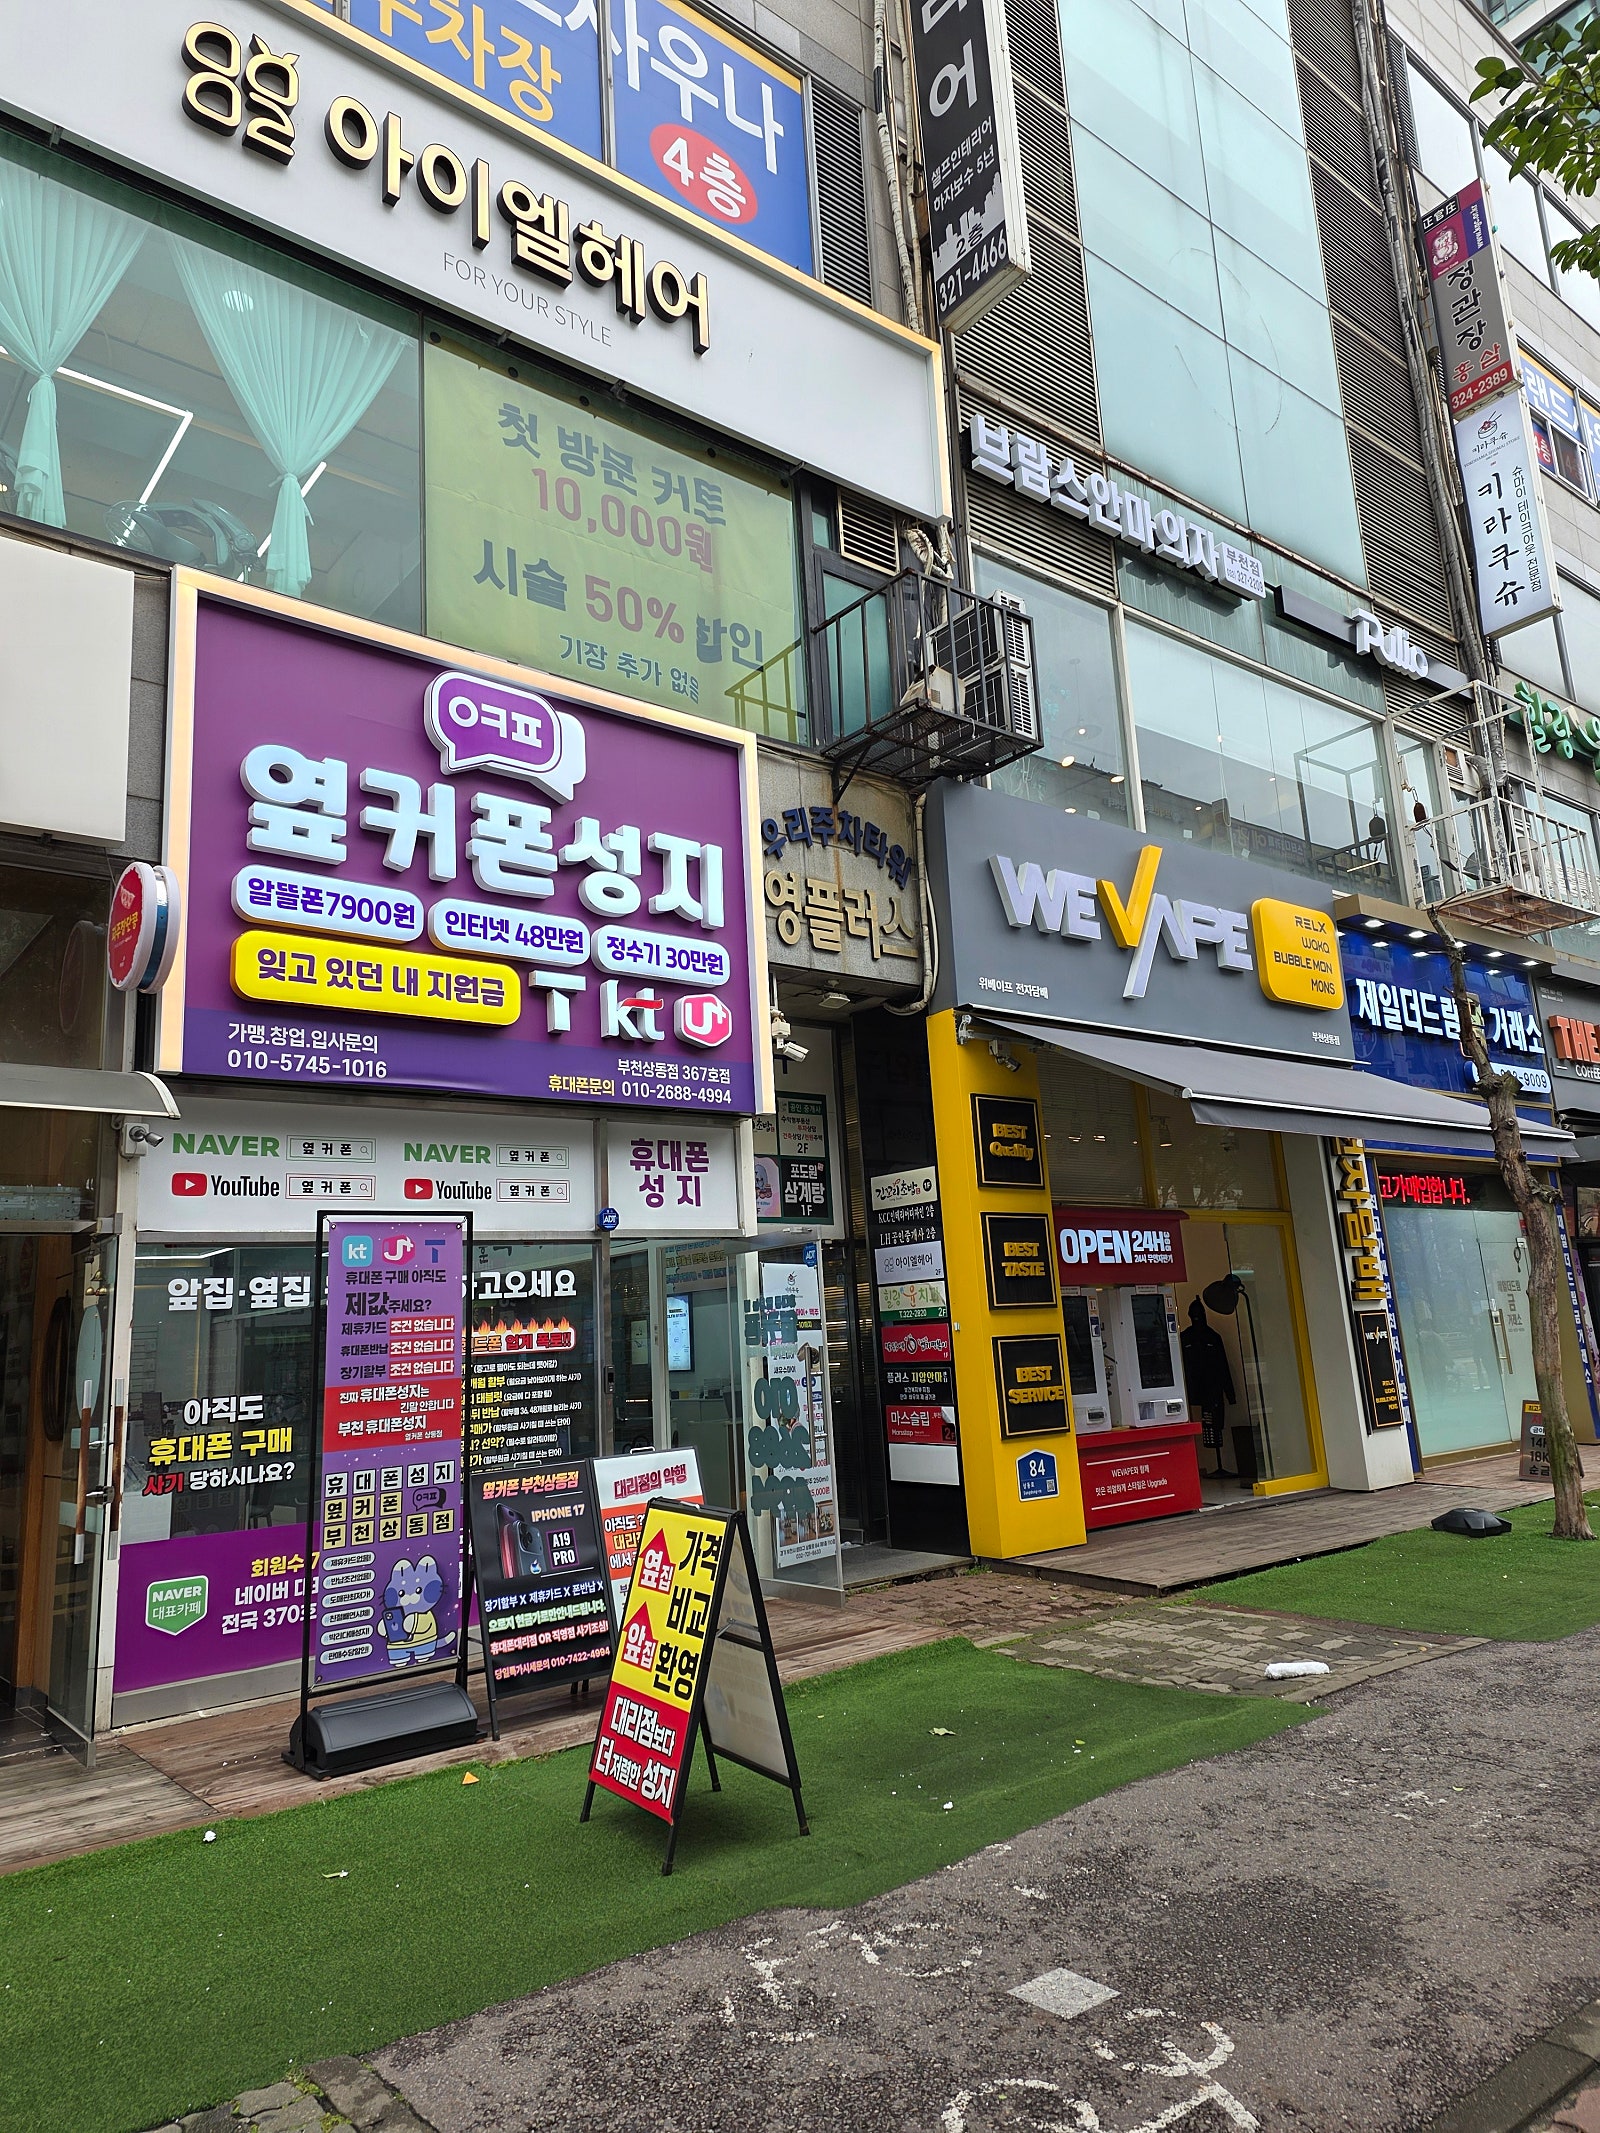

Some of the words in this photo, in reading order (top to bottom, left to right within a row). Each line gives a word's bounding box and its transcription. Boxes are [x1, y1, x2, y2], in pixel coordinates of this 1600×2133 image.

[931, 115, 993, 190] 셀프인테리어
[662, 137, 748, 219] 4층
[933, 168, 974, 213] 하자보수
[976, 144, 997, 173] 5년
[324, 95, 711, 355] 아이엘헤어
[955, 222, 984, 259] 2층
[939, 229, 1007, 313] 321-4466
[442, 252, 489, 289] FOR
[491, 275, 551, 318] YOUR
[555, 306, 613, 348] STYLE
[1447, 258, 1488, 351] 정관장
[1451, 371, 1508, 410] 324-2389
[498, 402, 541, 458] 첫
[557, 425, 638, 496] 방문
[969, 413, 1221, 583] 브람스안마의자
[532, 468, 714, 574] 10,000원
[1477, 472, 1525, 607] 키라쿠슈
[1227, 548, 1260, 577] 부천점
[473, 539, 567, 612] 시술
[584, 574, 685, 644] 50%
[560, 634, 607, 671] 기장
[617, 652, 662, 686] 추가
[239, 744, 725, 931] 옆커폰성지
[247, 877, 416, 931] 알뜰폰7900원
[765, 869, 918, 960] 영플러스
[445, 910, 509, 944] 인터넷
[514, 915, 585, 955] 48만원
[988, 844, 1253, 999] WEVAPE
[1295, 915, 1327, 934] RELX
[606, 935, 661, 966] 정수기
[666, 946, 724, 976] 30만원
[1274, 951, 1312, 970] BUBBLE
[1312, 960, 1333, 975] MON
[257, 948, 317, 984] 잊고
[327, 957, 382, 993] 있던
[393, 965, 419, 997] 내
[427, 972, 506, 1008] 지원금
[978, 976, 1014, 994] 위베이프
[1015, 982, 1049, 1000] 전자담배
[1311, 978, 1336, 995] MONS
[528, 970, 587, 1034] T
[601, 977, 665, 1043] kt
[1356, 978, 1461, 1040] 제일더드림
[1489, 1007, 1544, 1054] 거래소
[228, 1022, 379, 1055] 가맹.창업.입사문의
[227, 1050, 388, 1080] 010-5745-1016
[617, 1057, 679, 1080] 부천상동점
[682, 1063, 731, 1085] 367호점
[548, 1074, 614, 1097] 휴대폰문의
[621, 1080, 732, 1104] 010-2688-4994
[172, 1133, 280, 1157] NAVER
[992, 1123, 1027, 1139] BEST
[404, 1143, 491, 1164] NAVER
[630, 1139, 710, 1173] 휴대폰
[797, 1143, 808, 1154] 2F
[989, 1141, 1034, 1161] Quality
[791, 1164, 817, 1179] 포도원
[211, 1175, 279, 1198] YouTube
[436, 1181, 492, 1201] YouTube
[785, 1182, 825, 1204] 삼계탕
[801, 1205, 812, 1216] 1F
[348, 1243, 367, 1260] kt
[1004, 1242, 1039, 1258] BEST
[1060, 1228, 1132, 1264] OPEN
[1132, 1231, 1164, 1252] 24H
[896, 1253, 932, 1268] 아이엘헤어
[1002, 1261, 1045, 1277] TASTE
[345, 1271, 382, 1285] 휴대폰
[385, 1271, 408, 1284] 구매
[412, 1270, 446, 1283] 아직도
[341, 1322, 387, 1336] 제휴카드
[391, 1320, 412, 1333] 조건
[414, 1318, 454, 1331] 없습니다
[340, 1343, 388, 1357] 휴대폰반납
[391, 1341, 412, 1355] 조건
[414, 1339, 454, 1353] 없습니다
[340, 1366, 386, 1379] 장기할부
[391, 1363, 412, 1377] 조건
[414, 1360, 454, 1374] 없습니다
[1016, 1366, 1052, 1383] BEST
[340, 1391, 359, 1404] 진짜
[360, 1384, 429, 1401] 휴대폰성지는
[420, 1398, 454, 1412] 안합니다
[1009, 1386, 1065, 1405] SERVICE
[183, 1395, 263, 1425] 아직도
[891, 1410, 929, 1426] 마스슬립
[338, 1421, 364, 1436] 부천
[366, 1415, 426, 1434] 휴대폰성지
[149, 1432, 233, 1466] 휴대폰
[241, 1427, 293, 1457] 구매
[143, 1473, 183, 1496] 사기
[190, 1462, 296, 1491] 당하시나요?
[613, 1470, 662, 1500] 대리점의
[663, 1463, 687, 1485] 악행
[1029, 1459, 1046, 1477] 84
[483, 1480, 519, 1500] 옆커폰
[520, 1470, 580, 1494] 부천상동점
[531, 1506, 572, 1522] IPHONE
[573, 1503, 586, 1516] 17
[604, 1515, 637, 1533] 아직도
[552, 1531, 571, 1548] A19
[251, 1554, 304, 1577] 회원수
[553, 1550, 576, 1566] PRO
[678, 1530, 723, 1582] 가격
[153, 1585, 201, 1602] NAVER
[235, 1581, 288, 1605] 네이버
[484, 1595, 518, 1613] 장기할부
[529, 1588, 563, 1604] 제휴카드
[571, 1582, 596, 1596] 폰반납
[153, 1602, 200, 1620] 대표카페
[221, 1611, 257, 1634] 전국
[666, 1583, 712, 1639] 비교
[490, 1633, 538, 1656] 휴대폰대리점
[538, 1632, 552, 1644] OR
[552, 1627, 576, 1642] 직영점
[576, 1620, 609, 1638] 사기조심!
[551, 1646, 610, 1667] 010-7422-4994
[652, 1642, 700, 1701] 환영
